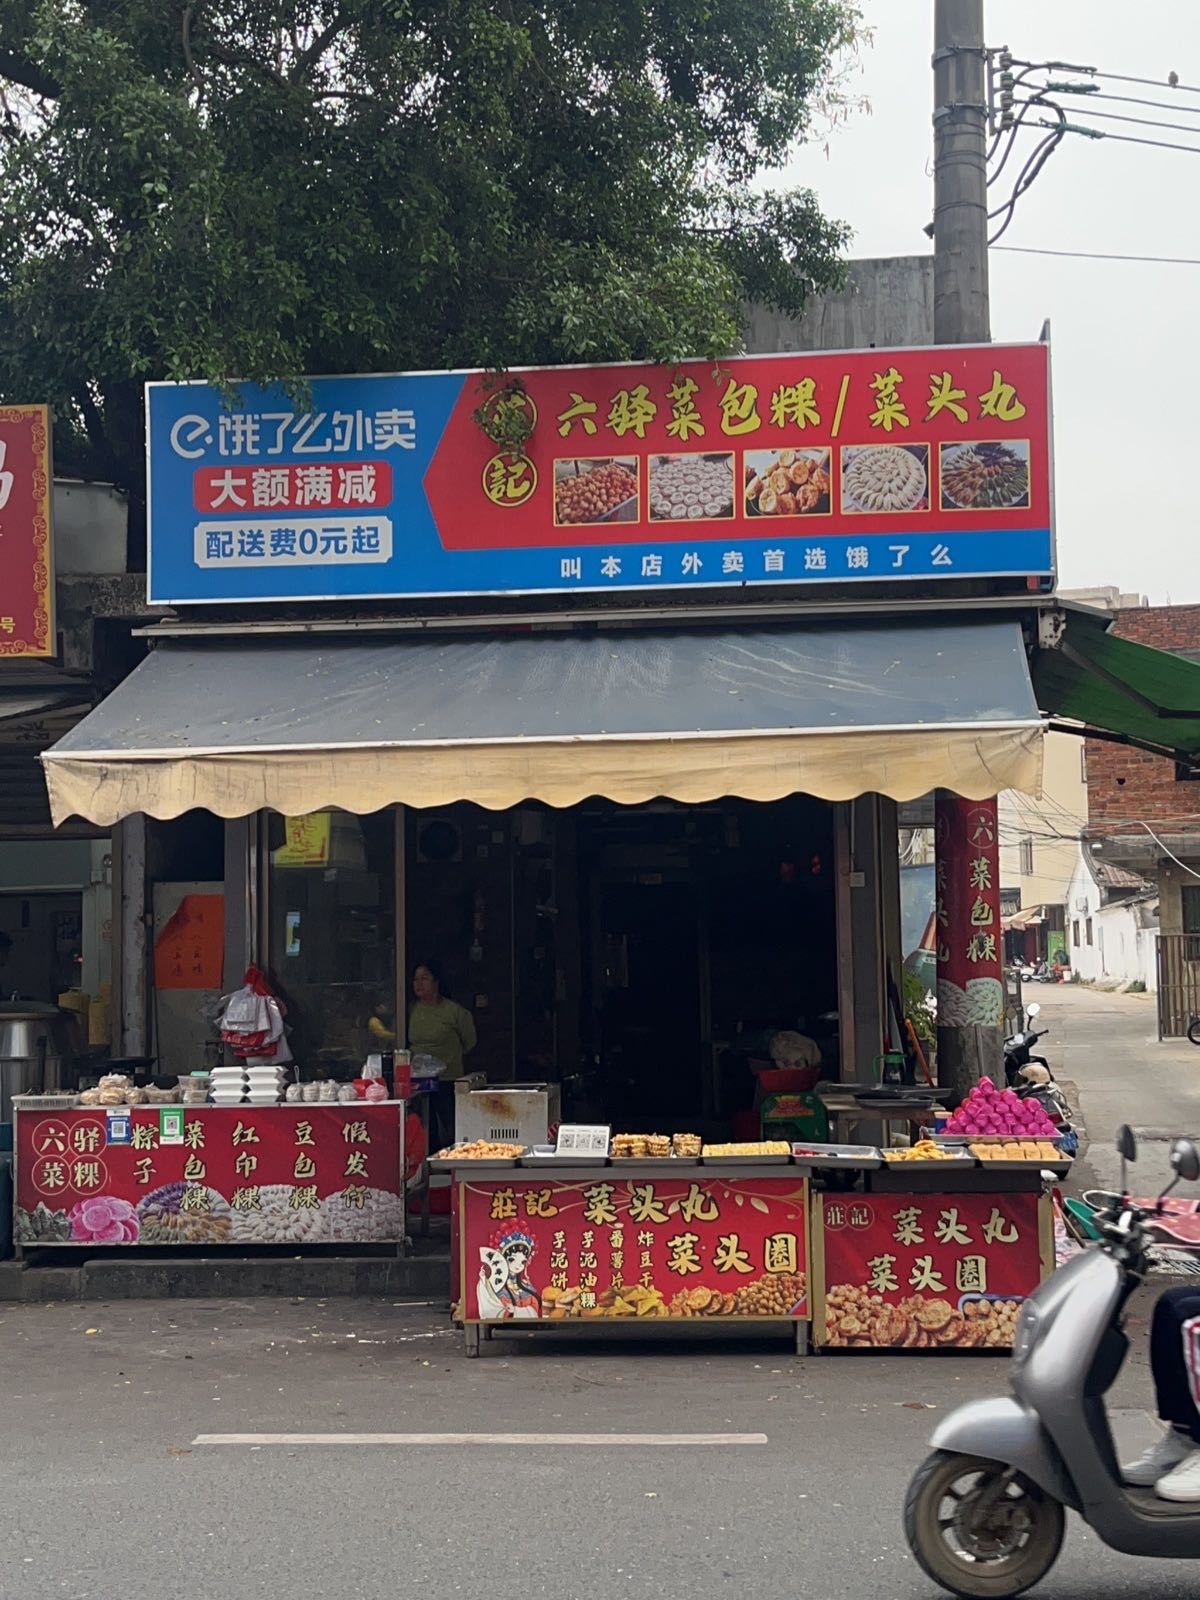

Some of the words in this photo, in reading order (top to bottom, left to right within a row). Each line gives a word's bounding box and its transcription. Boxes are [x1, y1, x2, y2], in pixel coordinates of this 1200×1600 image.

[218, 408, 417, 456] 饿了么外卖
[210, 464, 377, 509] 大额满减
[205, 525, 380, 559] 配送费0元起
[560, 543, 953, 580] 叫本店外卖首选饿了么
[130, 1123, 158, 1185] 粽子
[180, 1120, 209, 1211] 菜包粿
[231, 1121, 261, 1211] 红印粿
[288, 1121, 320, 1211] 豆包粿
[583, 1183, 721, 1225] 菜头丸
[892, 1206, 1019, 1246] 菜头丸
[608, 1230, 624, 1290] 番薯片
[637, 1230, 655, 1288] 炸豆干
[666, 1232, 798, 1276] 菜头圈
[866, 1253, 987, 1293] 菜头圈
